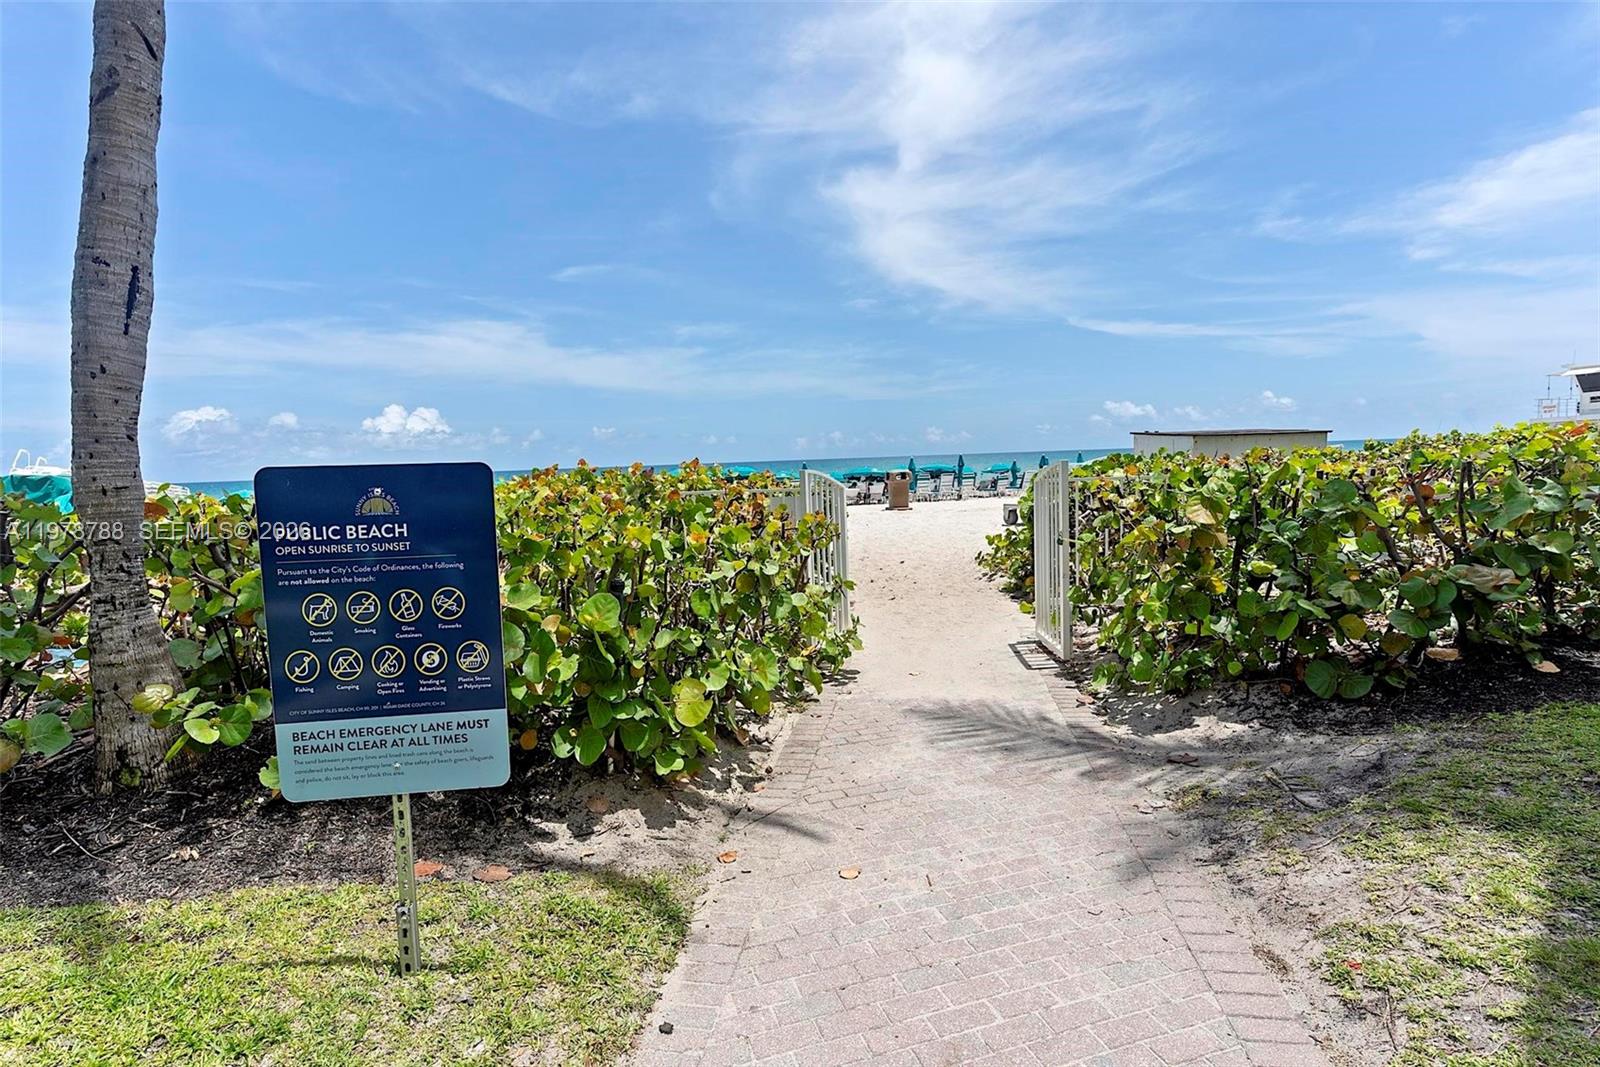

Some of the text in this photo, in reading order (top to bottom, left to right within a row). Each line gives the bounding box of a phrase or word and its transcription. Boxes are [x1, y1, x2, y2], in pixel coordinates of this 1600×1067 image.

[386, 494, 400, 516] BEACH
[275, 523, 408, 541] PUBLIC BEACH
[275, 541, 411, 556] OPEN SUNRISE TO SUNSET
[277, 568, 308, 576] Pursuant
[331, 565, 352, 575] City's
[352, 565, 371, 573] Code
[372, 564, 380, 572] of
[381, 563, 421, 571] Ordinances,
[422, 562, 434, 570] the
[434, 561, 464, 570] following
[303, 577, 330, 585] allowed
[341, 575, 353, 583] the
[353, 574, 376, 583] beach:
[353, 627, 377, 635] Smoking
[395, 631, 423, 639] Containers
[336, 683, 360, 691] Camping
[376, 681, 398, 689] Cooking
[419, 678, 440, 686] Vending
[292, 719, 490, 742] BEACH EMERGENCY LANE MUST
[293, 733, 468, 755] REMAIN CLEAR AT ALL TIMES
[341, 755, 364, 764] property
[350, 764, 380, 772] emergency
